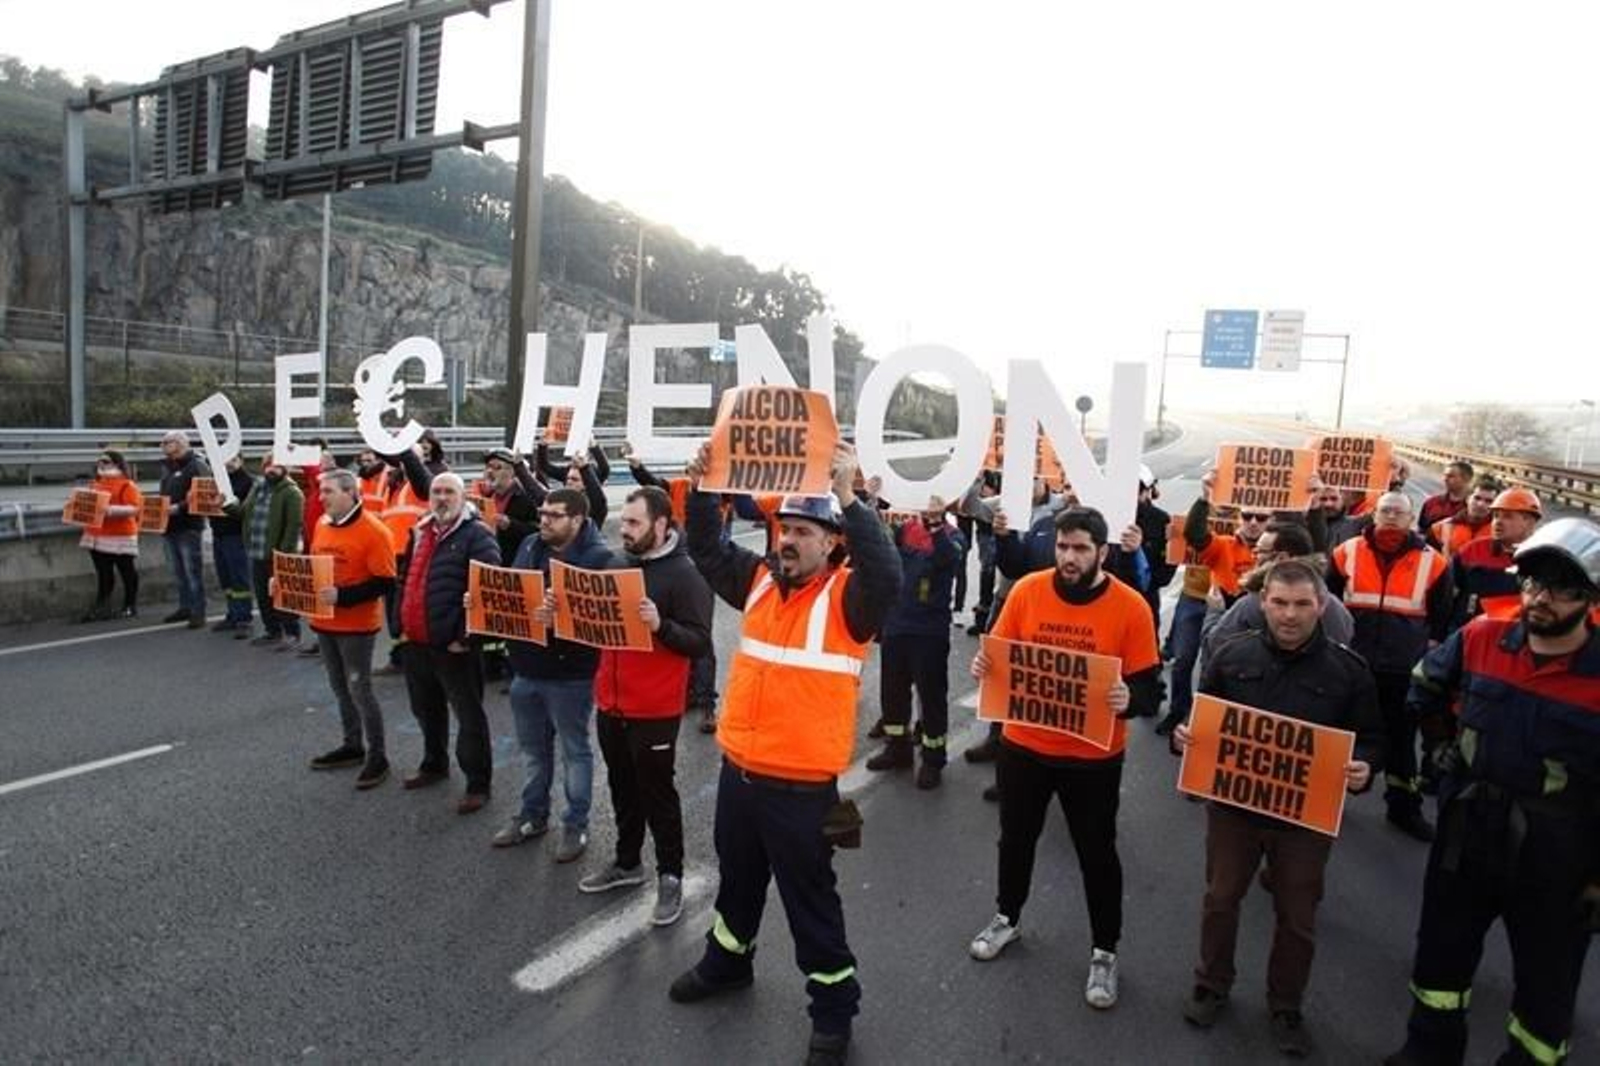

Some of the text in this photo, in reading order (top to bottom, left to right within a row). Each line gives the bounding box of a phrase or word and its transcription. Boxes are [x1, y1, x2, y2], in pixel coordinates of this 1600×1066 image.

[730, 388, 810, 422] ALCOA
[729, 424, 808, 458] PECHE
[1320, 436, 1375, 455] ALCOA
[1234, 446, 1295, 467] ALCOA
[1318, 453, 1373, 472] PECHE
[727, 459, 806, 492] NON!!!
[1232, 467, 1293, 488] PECHE
[1230, 487, 1291, 508] NON!!!
[276, 553, 315, 577] ALCOA
[278, 574, 317, 594] PECHE
[479, 566, 525, 594] ALCOA
[563, 567, 619, 597] ALCOA
[481, 590, 528, 616] PECHE
[566, 592, 624, 622] PECHE
[485, 612, 531, 638] NON!!!
[573, 617, 628, 646] NON!!!
[1009, 643, 1089, 681] ALCOA
[1010, 668, 1087, 708] PECHE
[1007, 694, 1086, 736] NON!!!
[1219, 704, 1315, 756] ALCOA
[1217, 737, 1312, 788] PECHE
[1211, 768, 1306, 821] NON!!!
